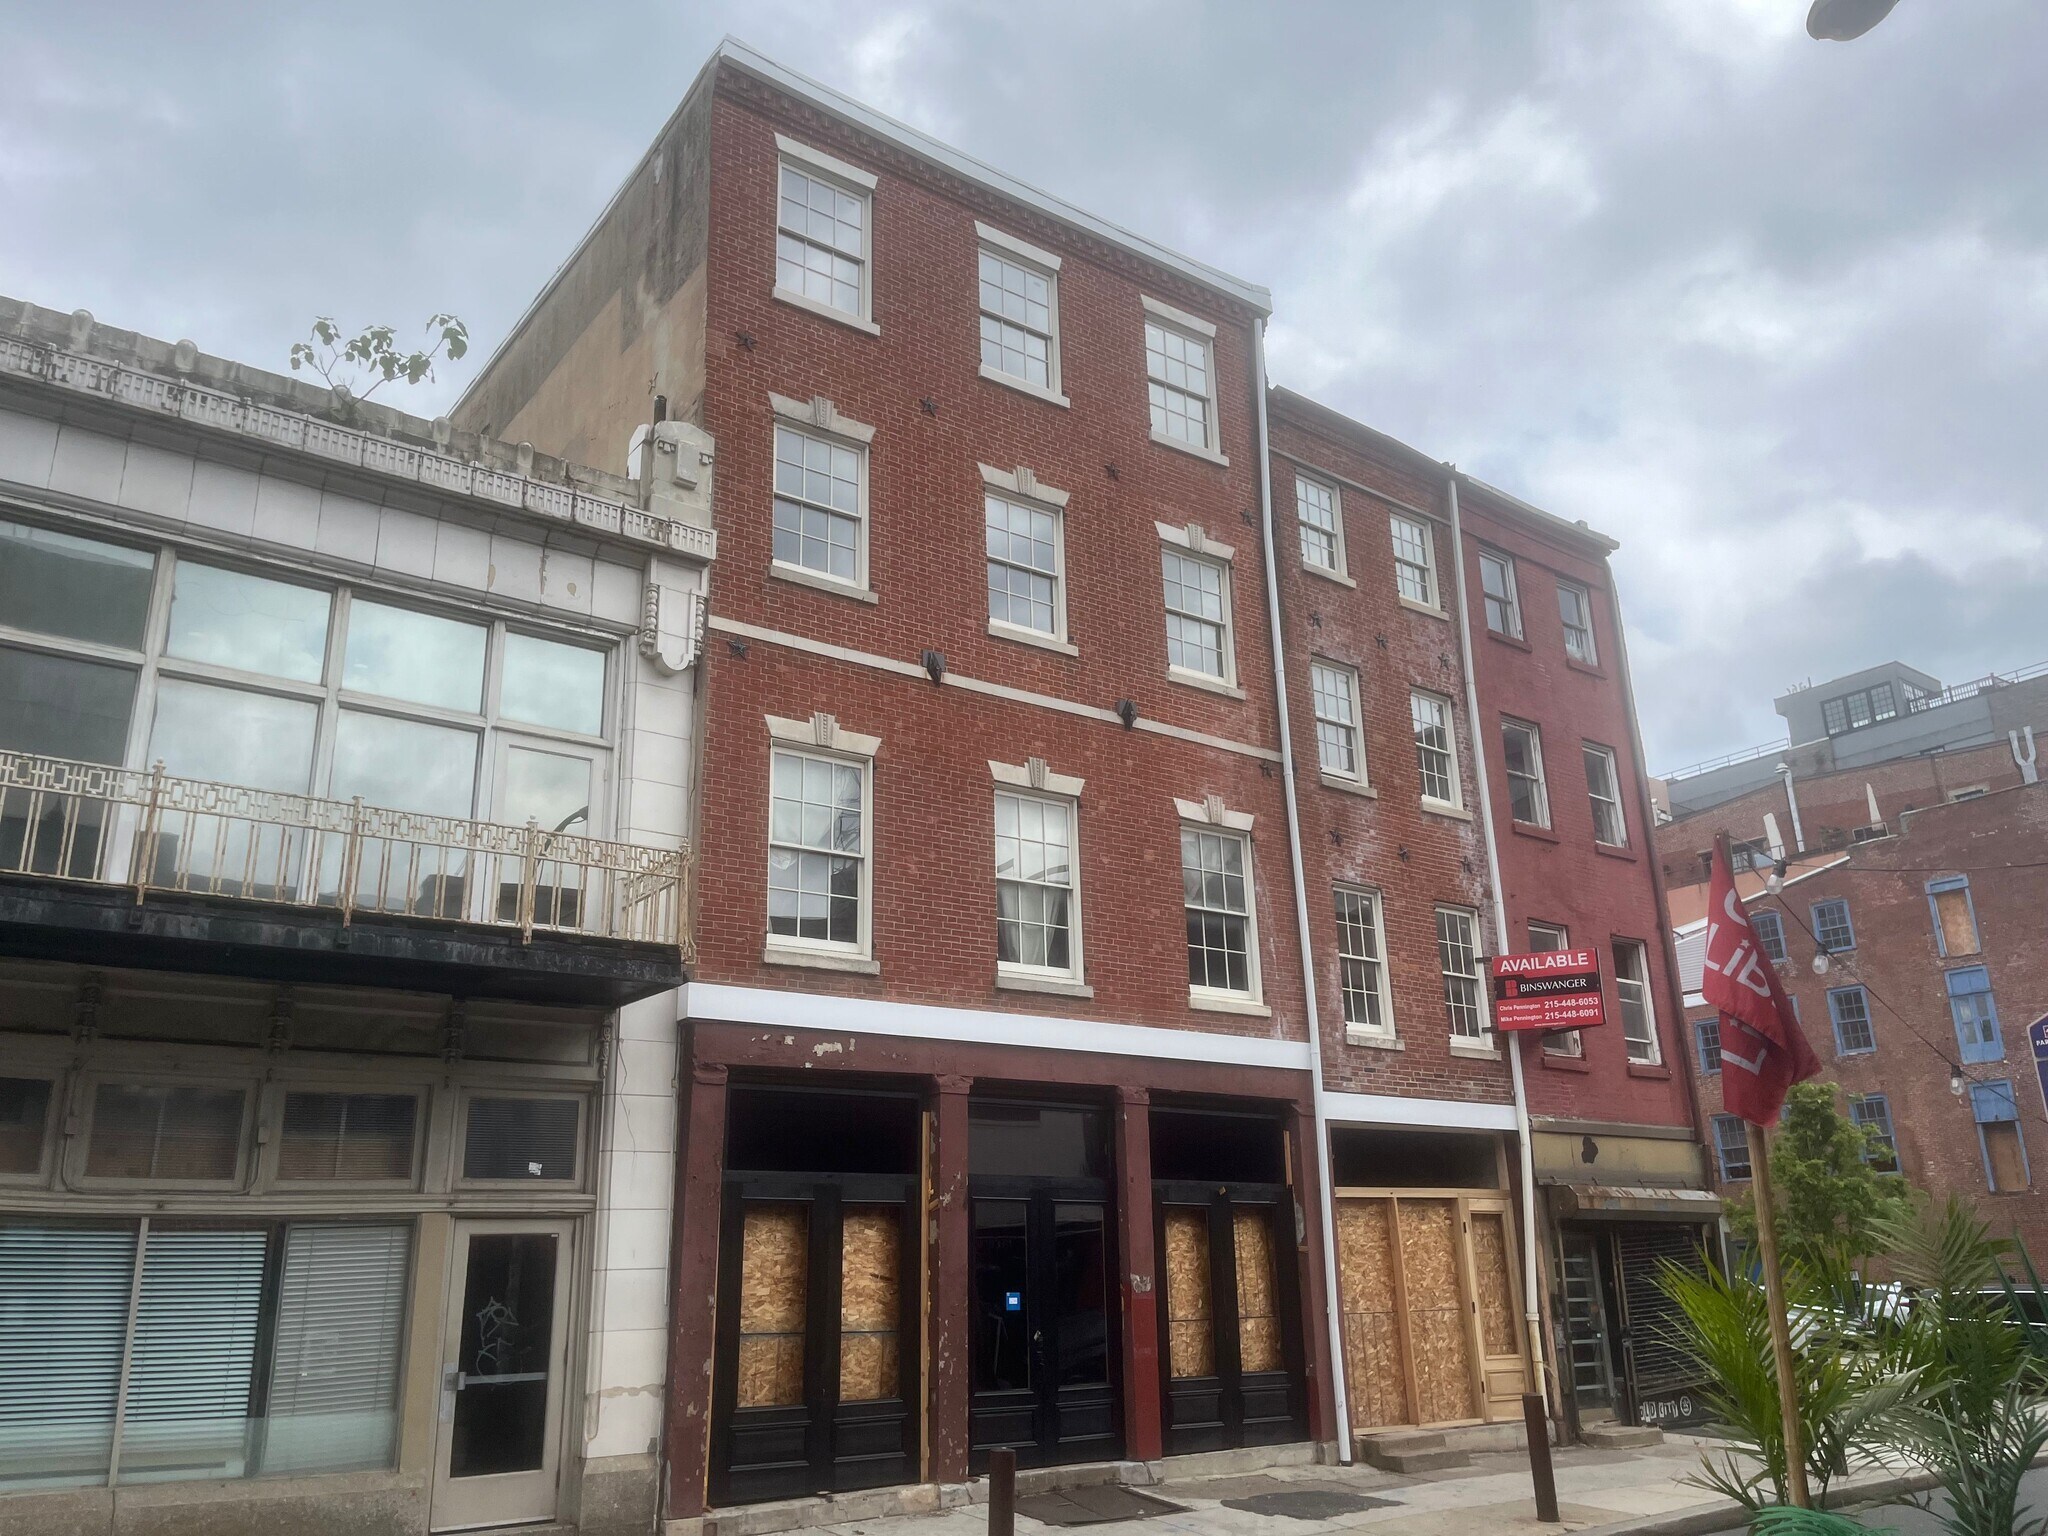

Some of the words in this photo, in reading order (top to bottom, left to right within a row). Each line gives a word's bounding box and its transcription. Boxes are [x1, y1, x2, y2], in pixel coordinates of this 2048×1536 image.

[1500, 953, 1589, 972] AVAILABLE
[1520, 979, 1587, 992] BINSWANGER
[1544, 997, 1599, 1009] 215-448-6053
[1545, 1009, 1599, 1020] 215-448-6091
